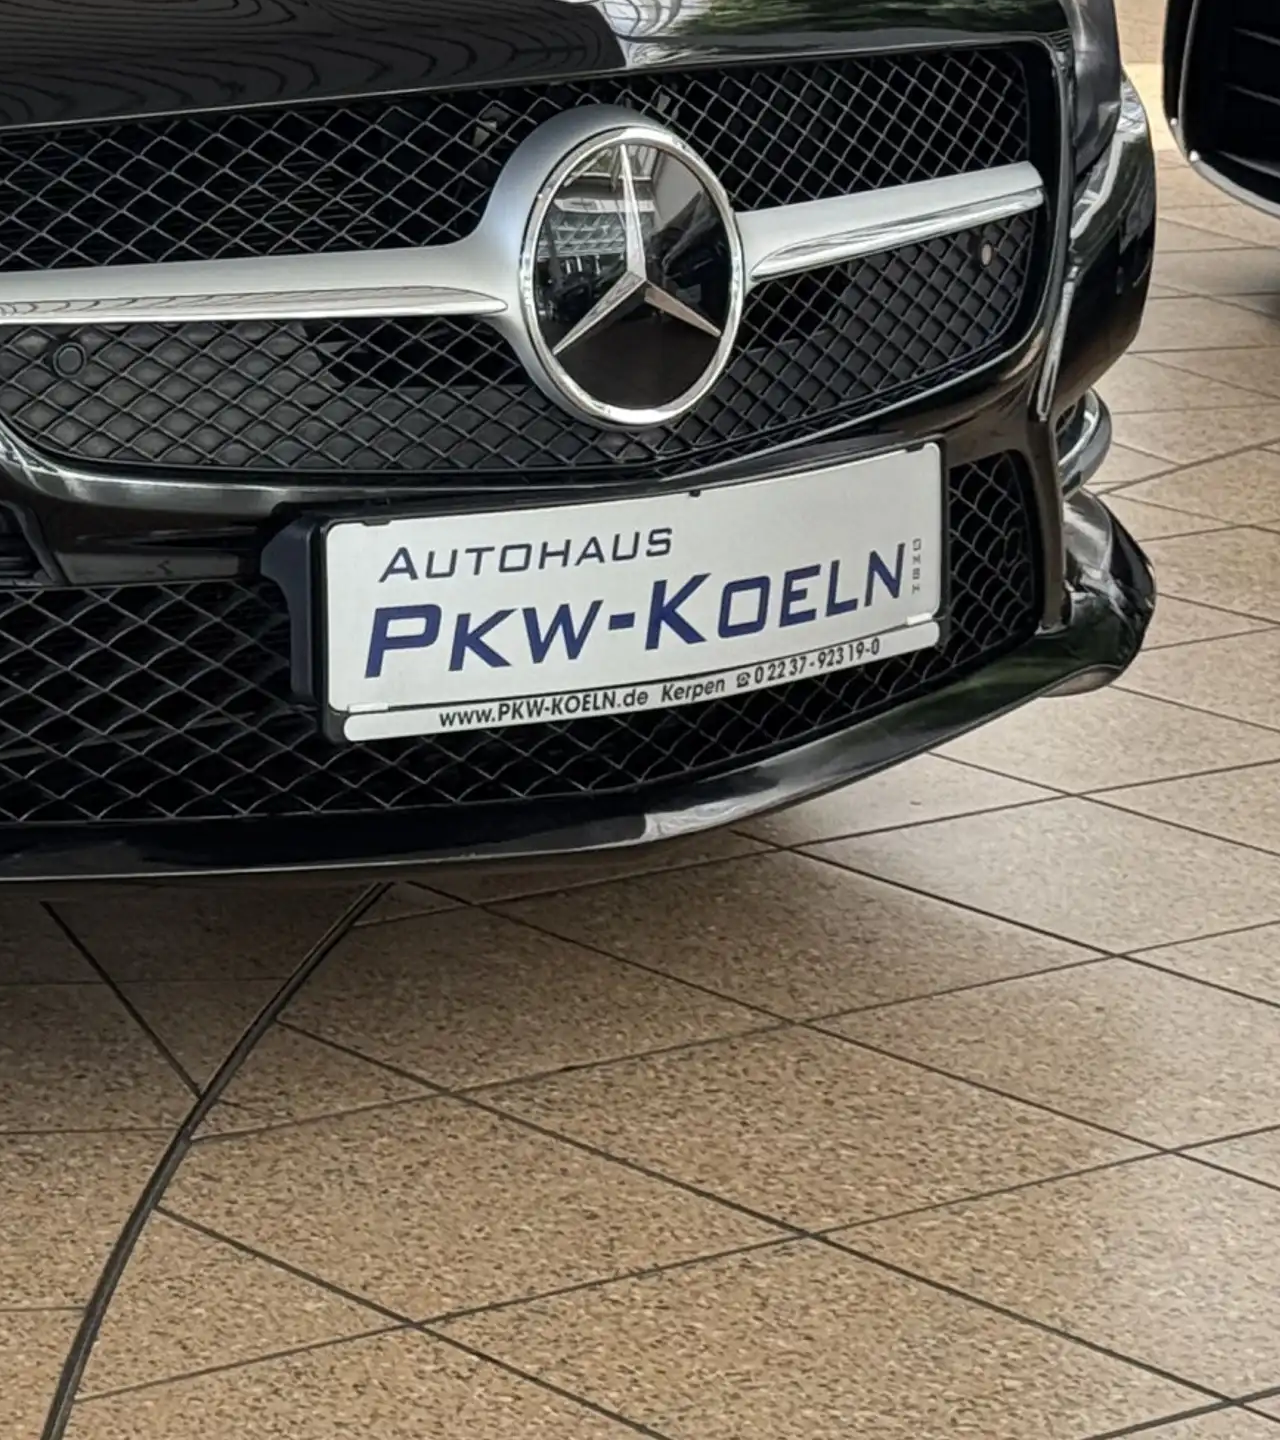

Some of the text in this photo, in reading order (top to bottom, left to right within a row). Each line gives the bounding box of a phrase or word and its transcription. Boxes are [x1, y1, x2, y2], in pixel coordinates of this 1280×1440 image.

[378, 527, 673, 583] AUTOHAUS
[364, 542, 906, 678] PKW-KOELN
[439, 688, 648, 728] www.PKW-KOELN.de
[661, 677, 725, 702] Kerpen
